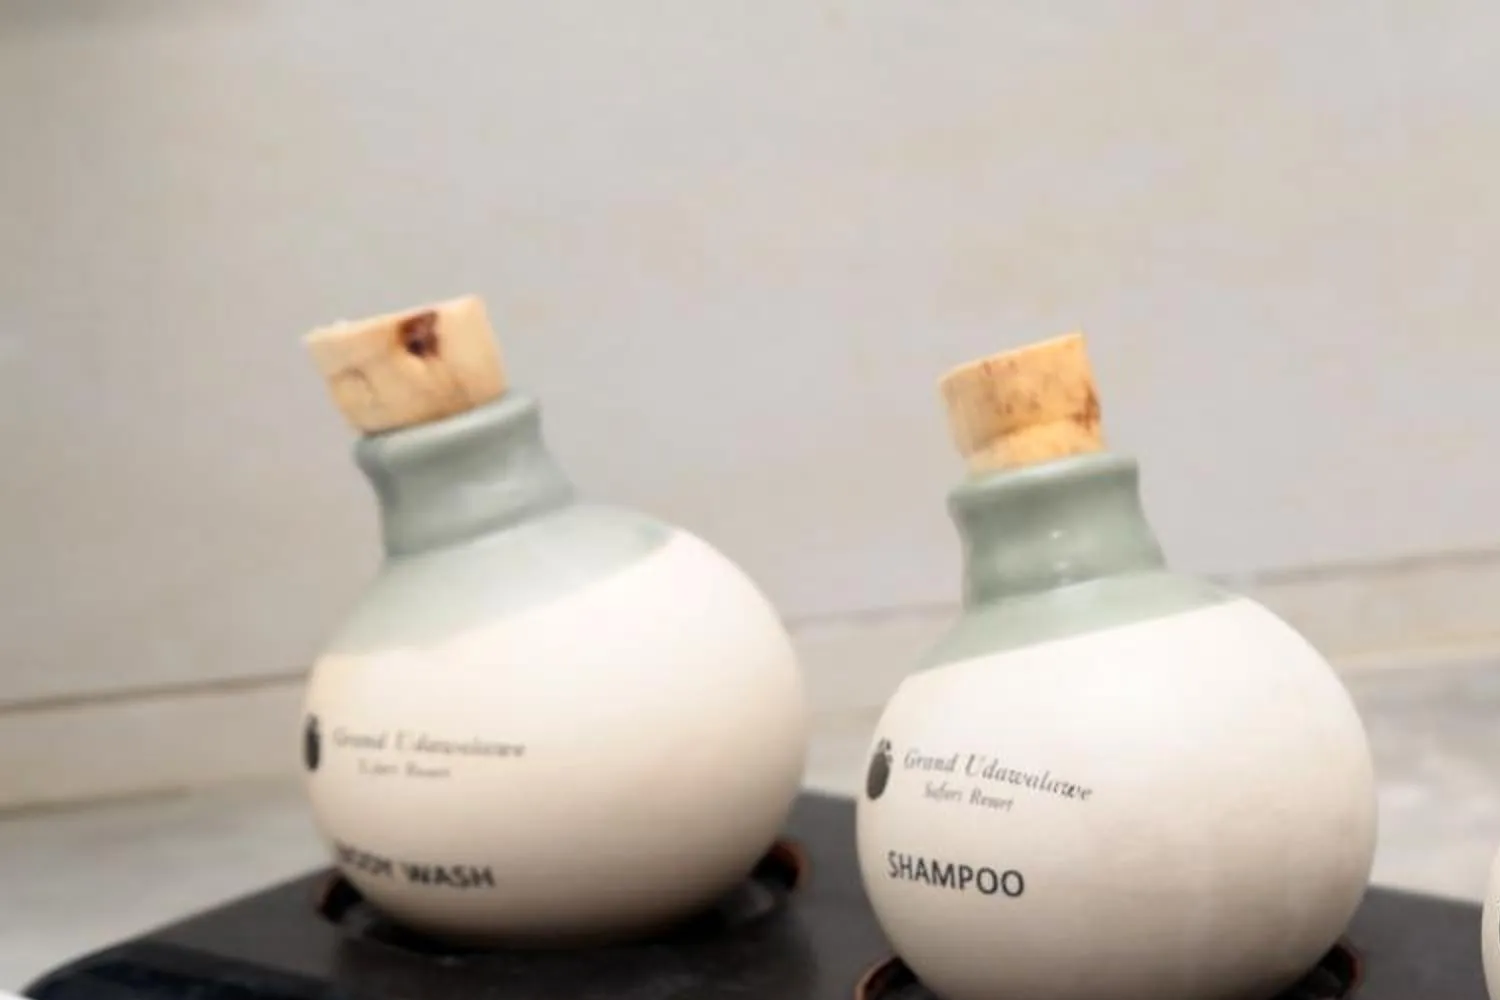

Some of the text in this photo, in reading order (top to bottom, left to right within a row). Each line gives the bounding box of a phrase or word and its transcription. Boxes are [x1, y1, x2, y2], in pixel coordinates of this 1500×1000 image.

[903, 749, 1094, 801] Grand Udawalawe
[969, 787, 1015, 813] Resort
[886, 849, 1026, 898] SHAMPOO
